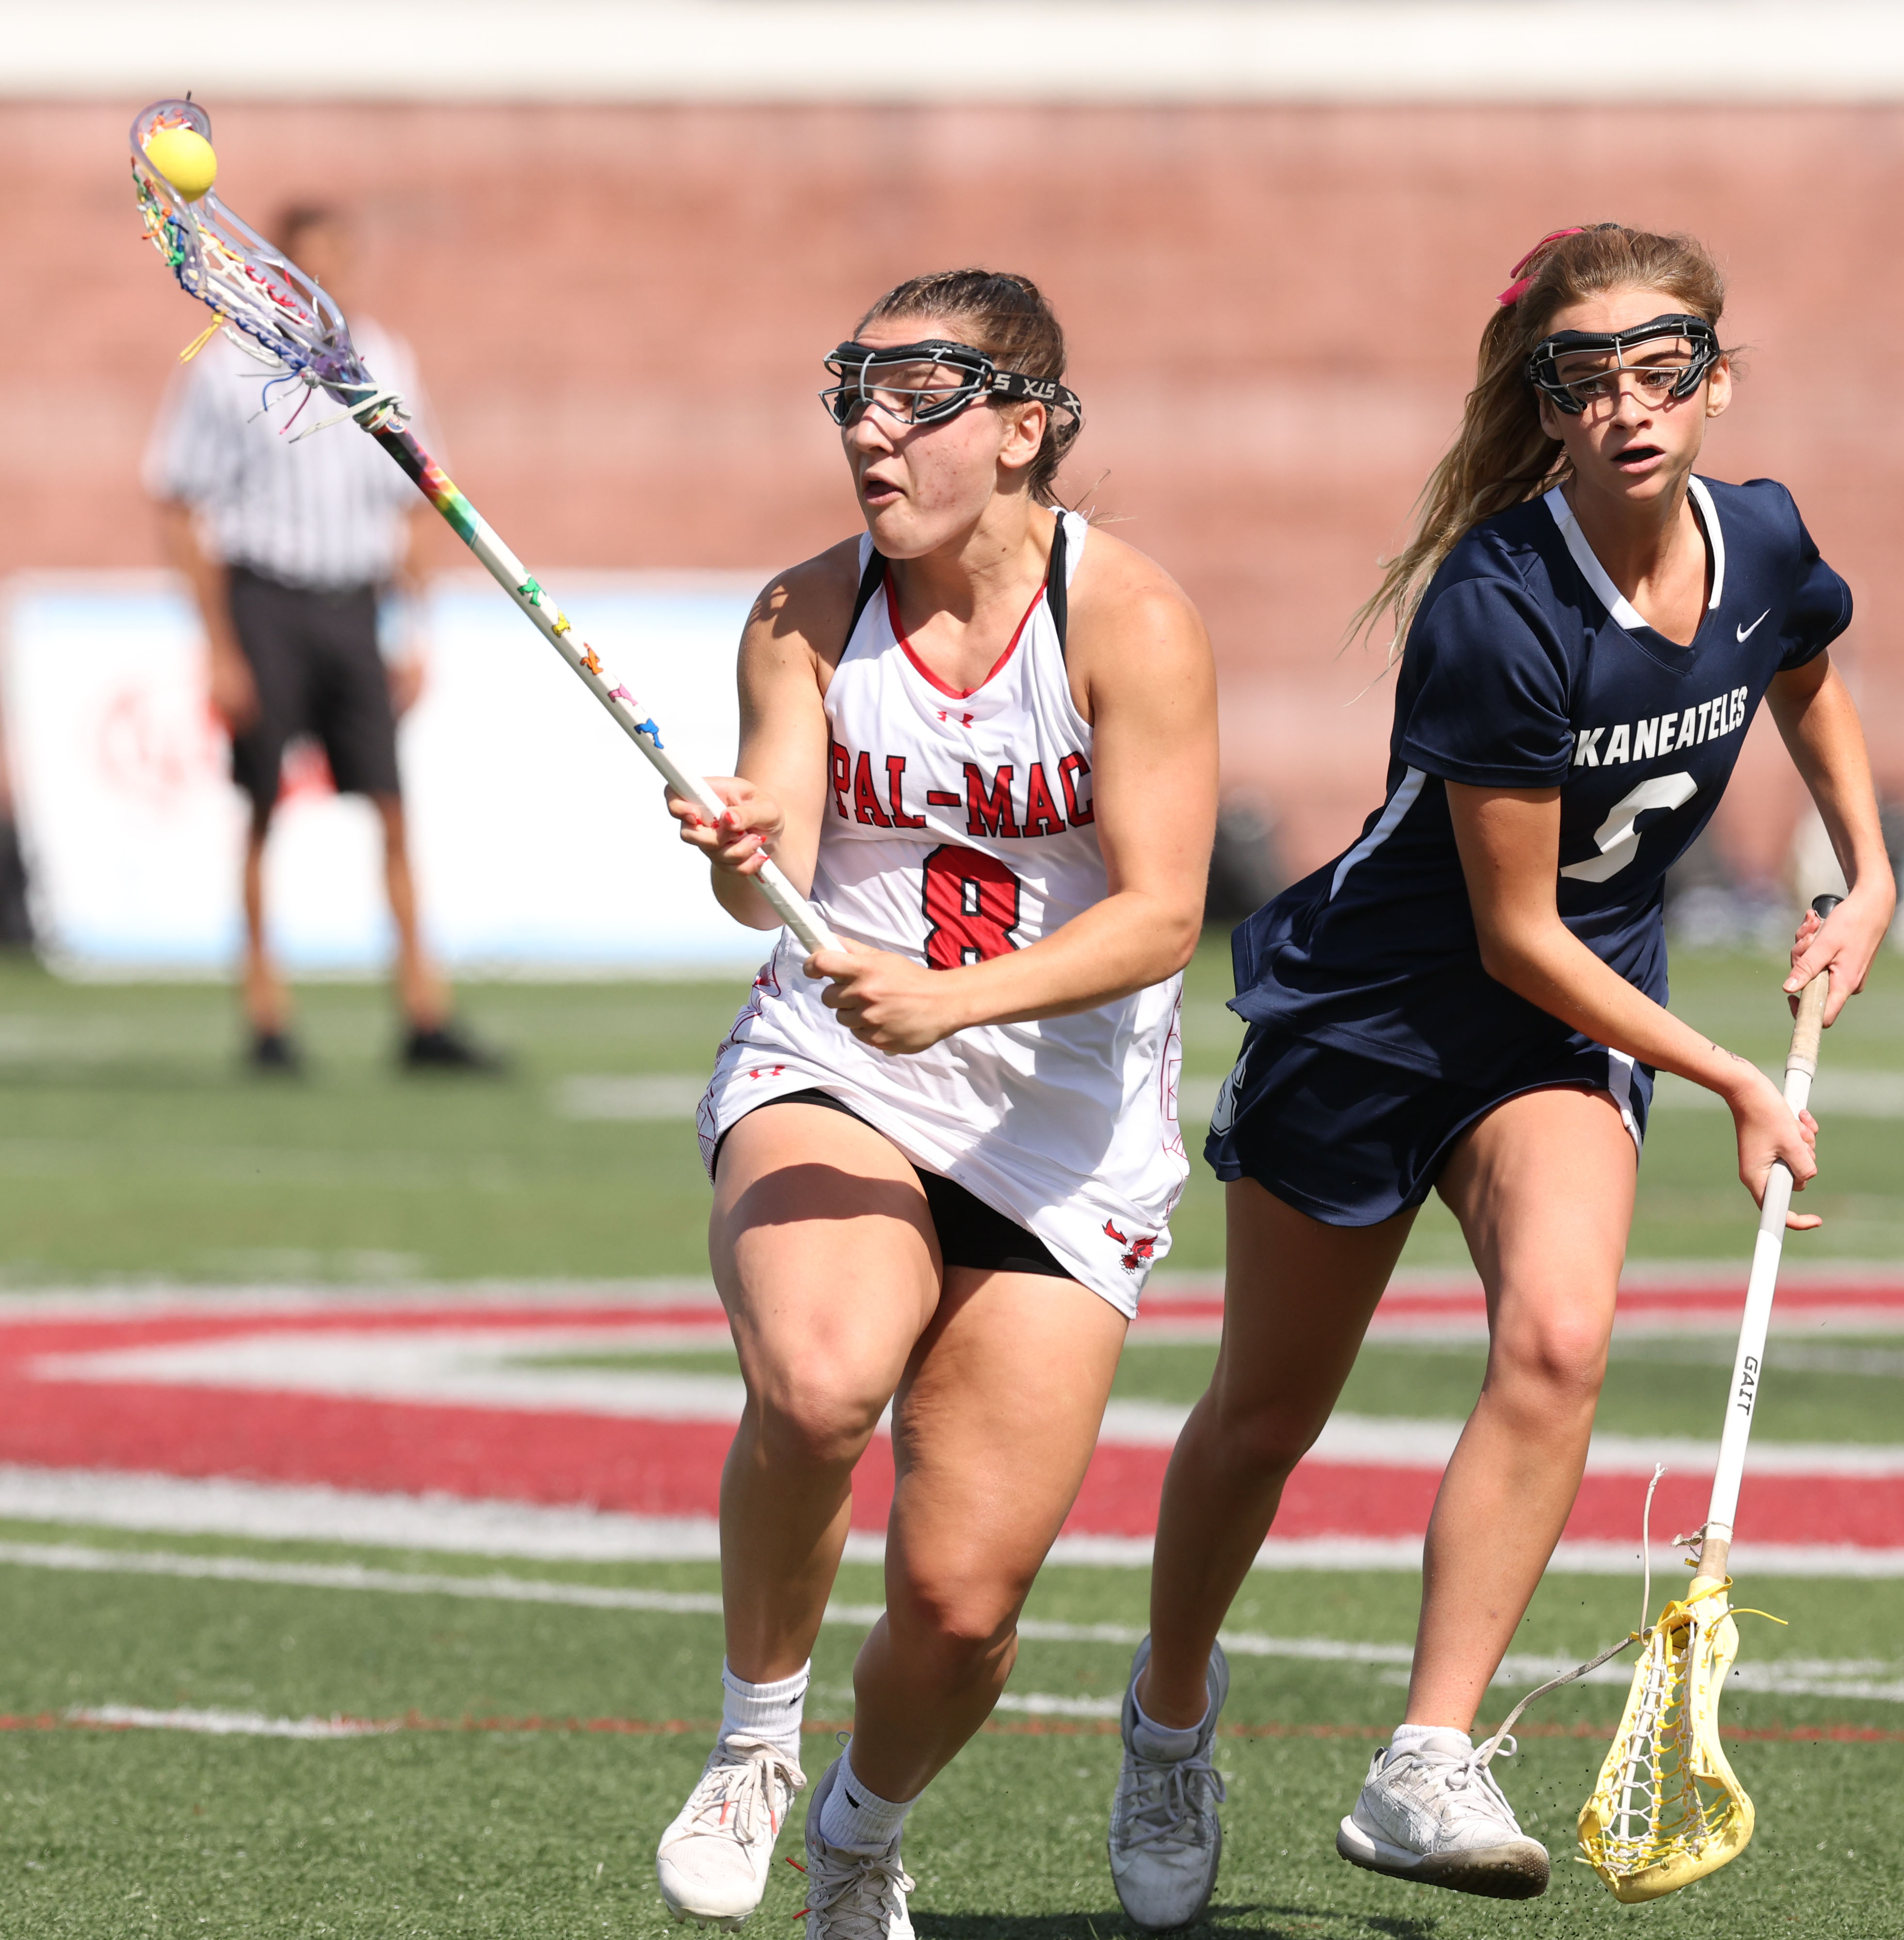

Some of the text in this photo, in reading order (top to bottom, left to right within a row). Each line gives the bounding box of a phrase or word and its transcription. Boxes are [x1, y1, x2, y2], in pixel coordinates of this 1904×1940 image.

[1022, 378, 1056, 400] STX
[832, 740, 1095, 838] PAL-MAC
[923, 843, 1021, 970] 8
[1737, 1356, 1759, 1416] GAIT
